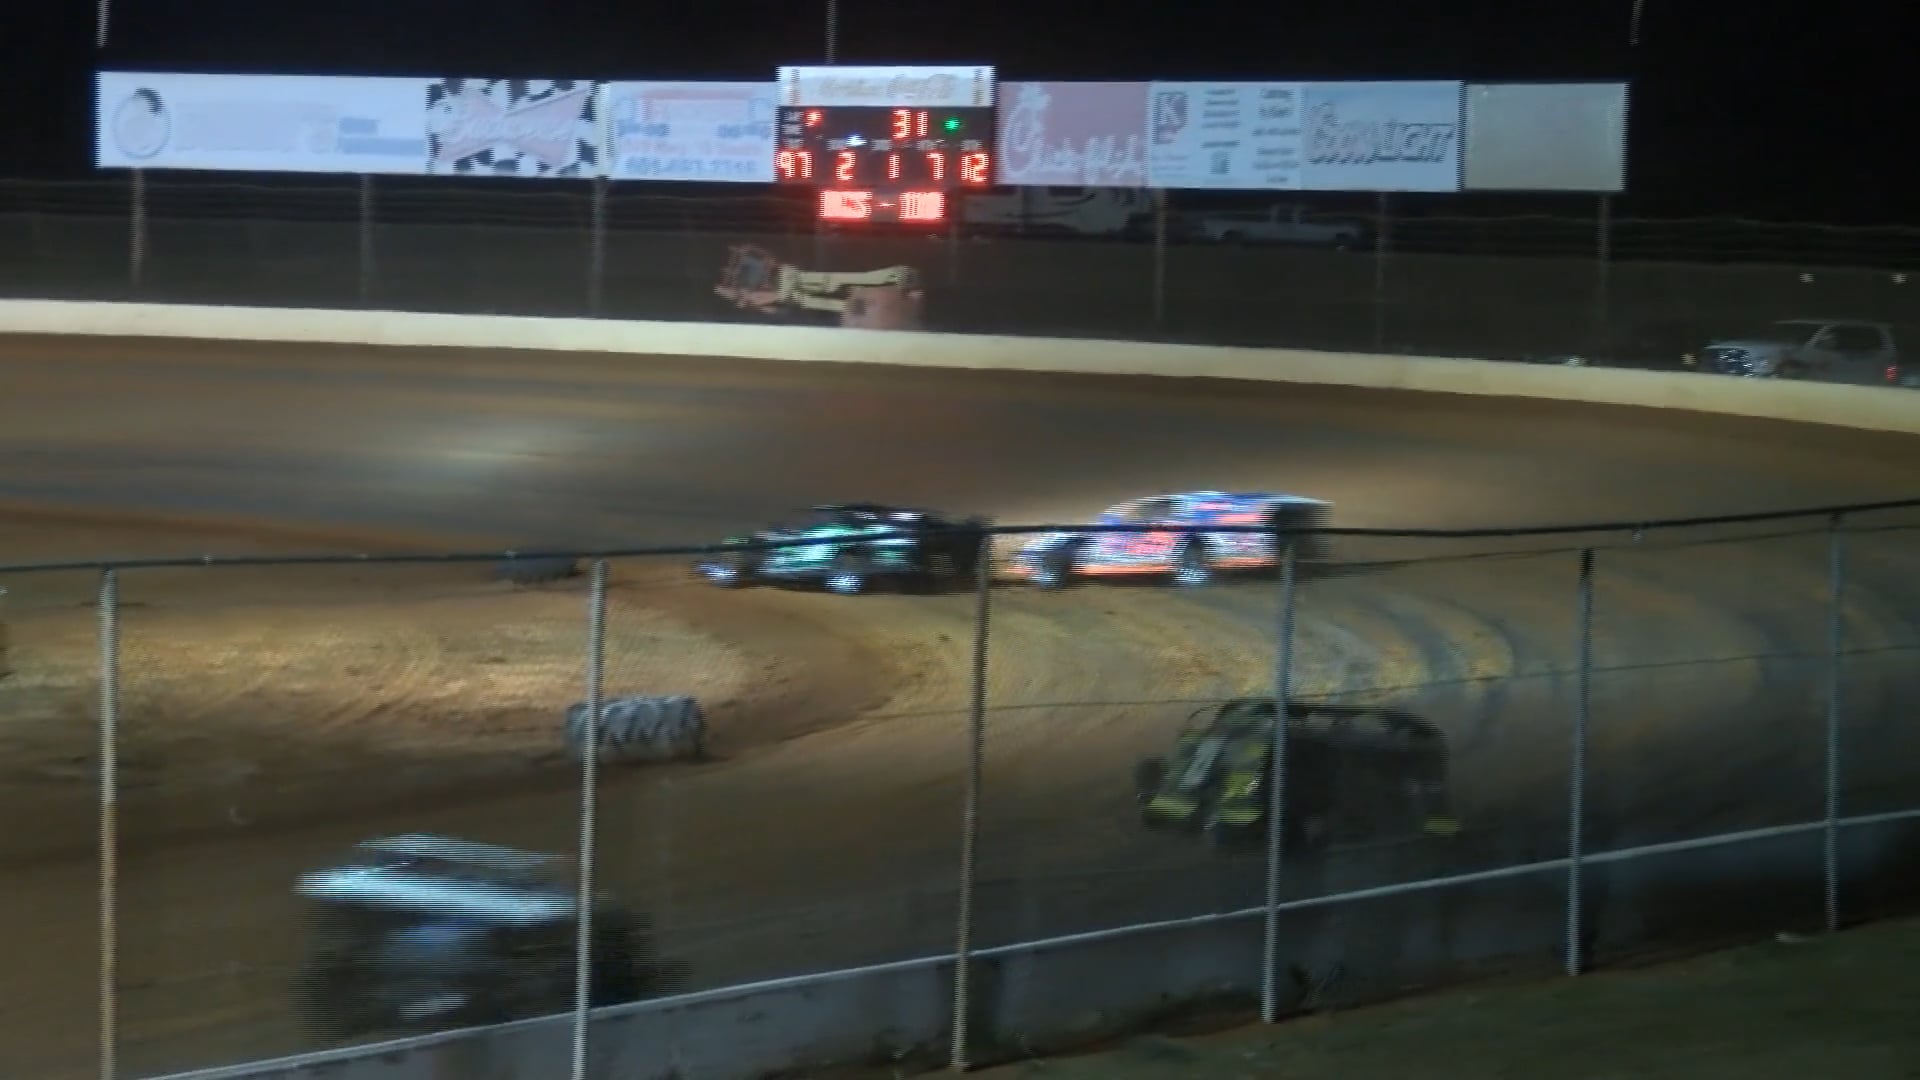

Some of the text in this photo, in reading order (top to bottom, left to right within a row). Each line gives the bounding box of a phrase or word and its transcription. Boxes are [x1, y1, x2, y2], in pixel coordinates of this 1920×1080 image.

[892, 109, 929, 138] 31
[777, 151, 813, 181] 97
[835, 151, 857, 181] 2
[888, 153, 901, 180] 1
[927, 152, 945, 181] 7
[961, 152, 990, 182] 12
